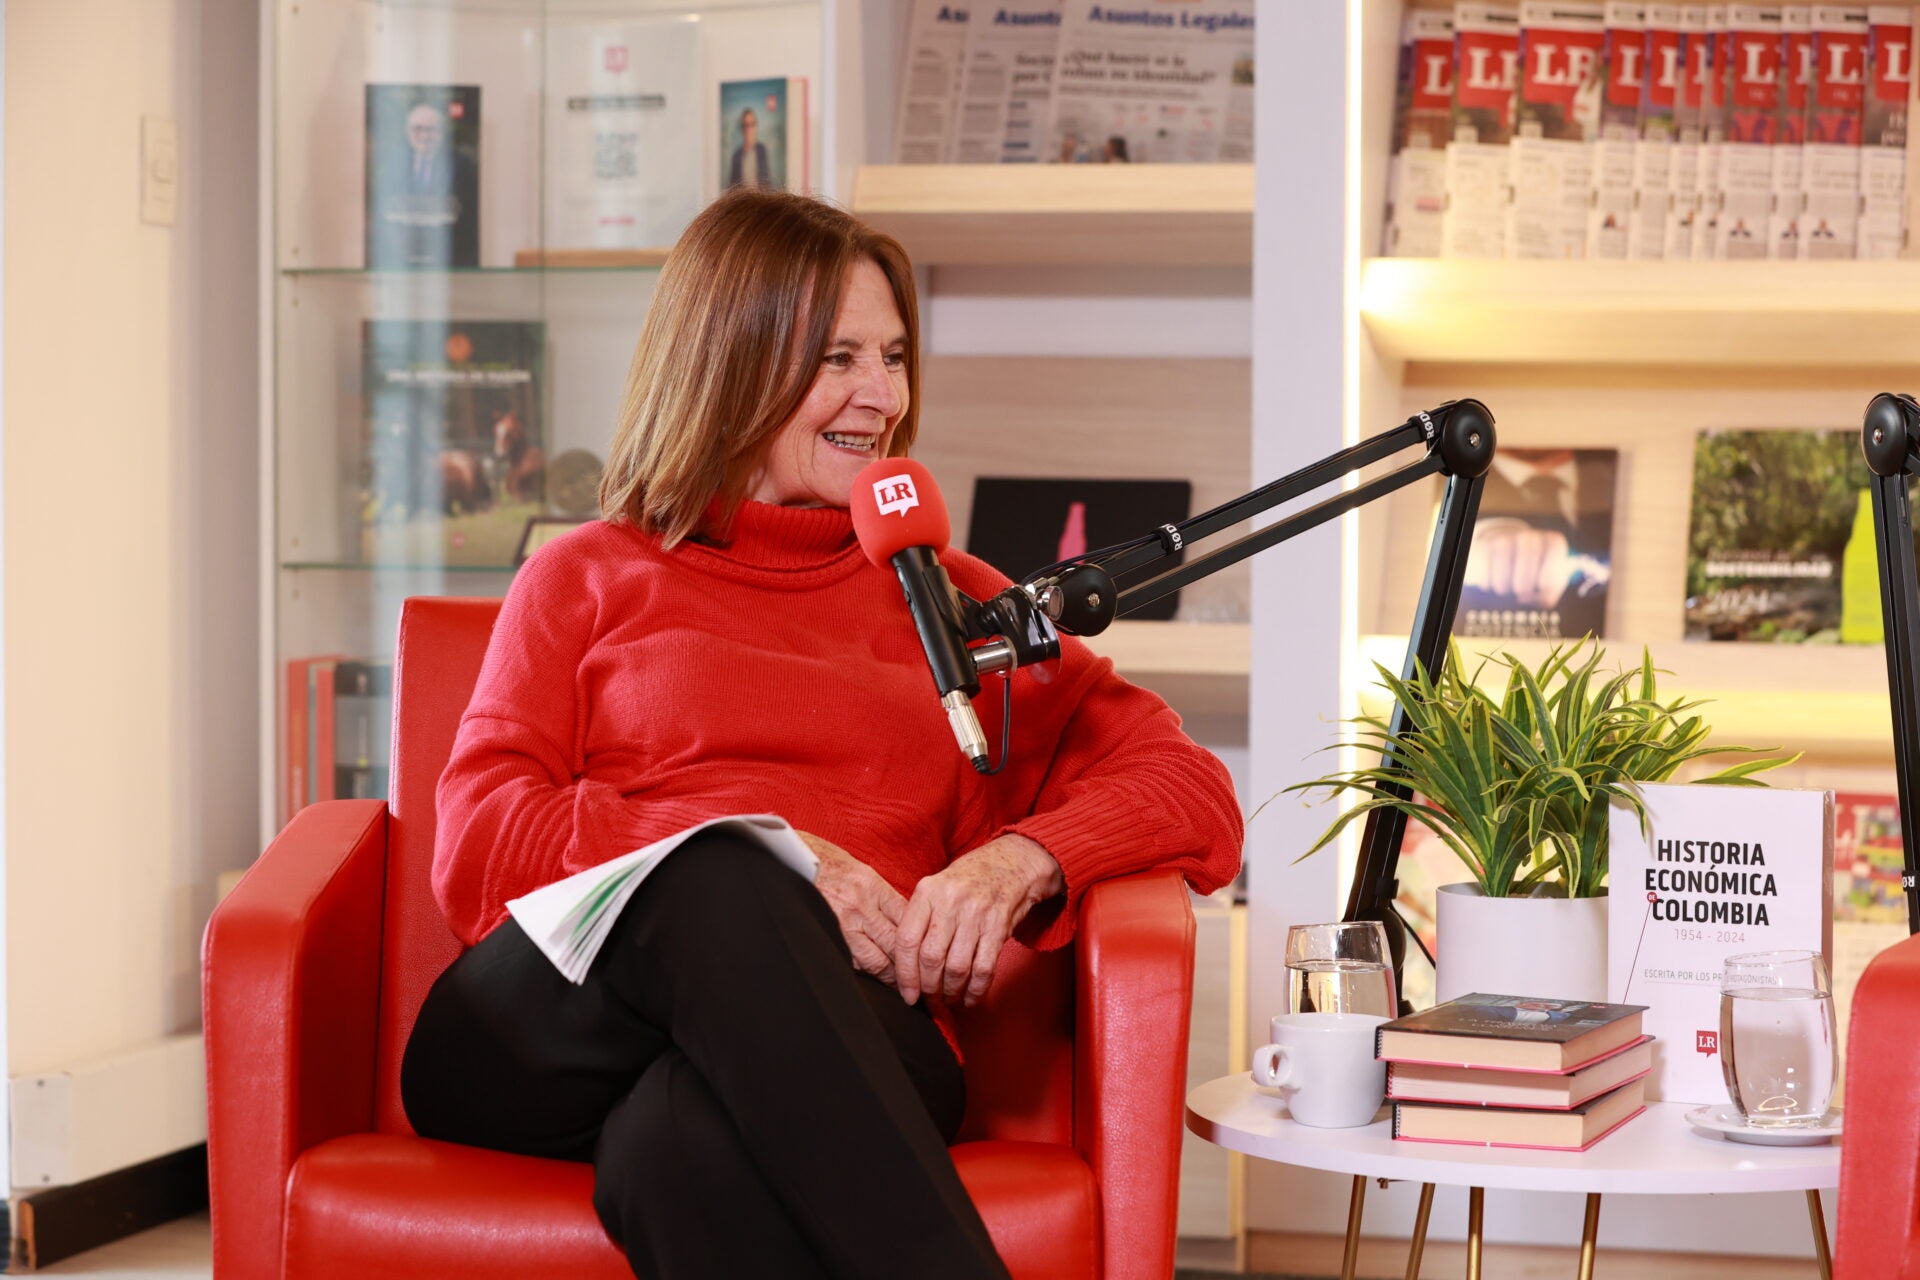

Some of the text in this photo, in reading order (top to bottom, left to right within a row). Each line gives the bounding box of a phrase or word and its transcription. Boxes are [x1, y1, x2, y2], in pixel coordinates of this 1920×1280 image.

[1089, 6, 1174, 27] Asuntos
[1533, 43, 1598, 89] LR
[1415, 410, 1435, 440] RØD
[878, 482, 913, 505] LR
[1158, 523, 1183, 551] RØD
[1657, 839, 1766, 866] HISTORIA
[1645, 864, 1778, 896] ECONÓMICA
[1649, 894, 1656, 902] DE
[1652, 898, 1770, 926] COLOMBIA
[1675, 928, 1703, 941] 1954
[1716, 931, 1745, 943] 2024
[1644, 968, 1675, 979] ESCRITA
[1678, 970, 1693, 981] POR
[1696, 972, 1710, 982] LOS
[1698, 1036, 1716, 1049] LR
